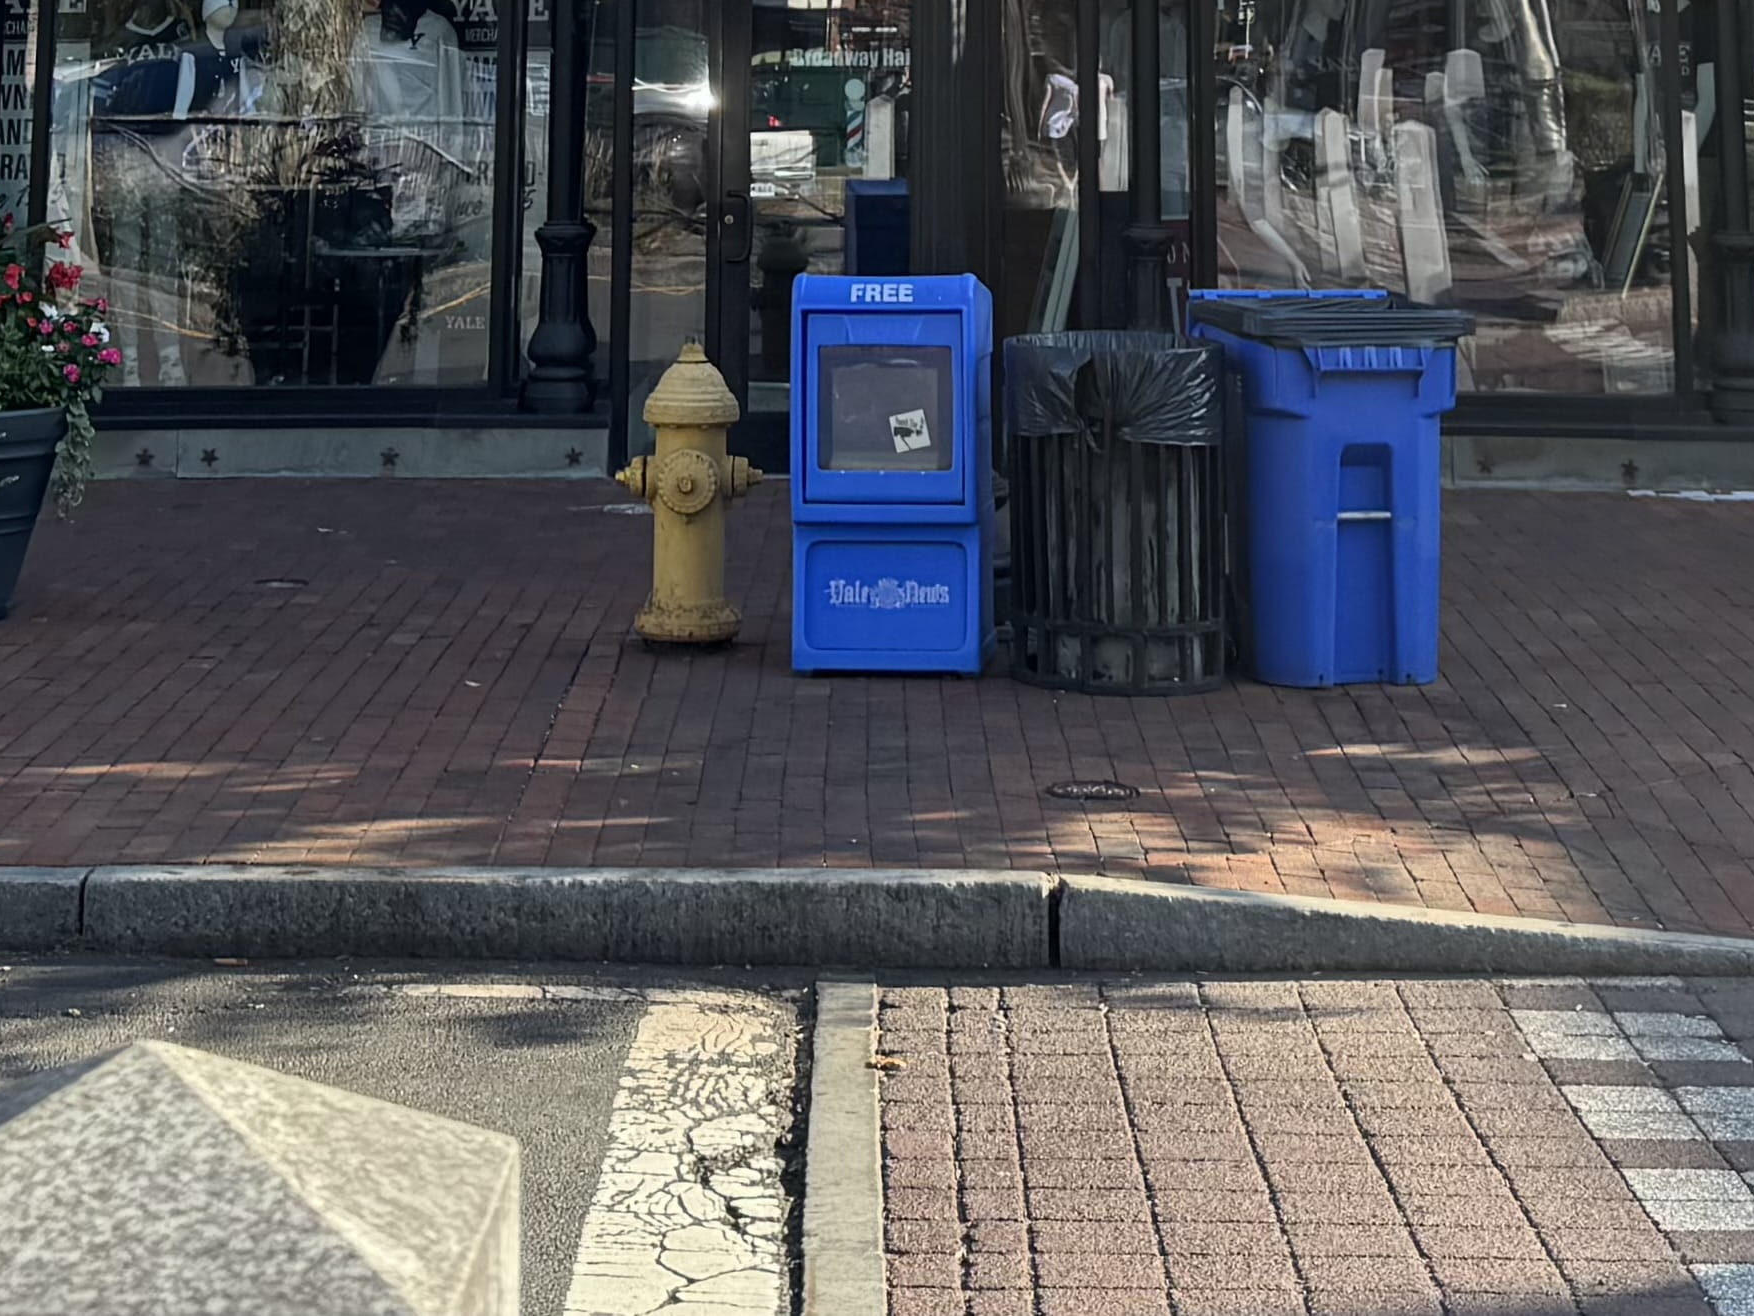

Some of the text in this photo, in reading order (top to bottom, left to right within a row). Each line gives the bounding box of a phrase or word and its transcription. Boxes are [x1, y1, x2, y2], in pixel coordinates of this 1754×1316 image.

[882, 48, 912, 67] Hai
[850, 282, 914, 303] FREE
[445, 315, 486, 330] YALE
[905, 579, 950, 604] News
